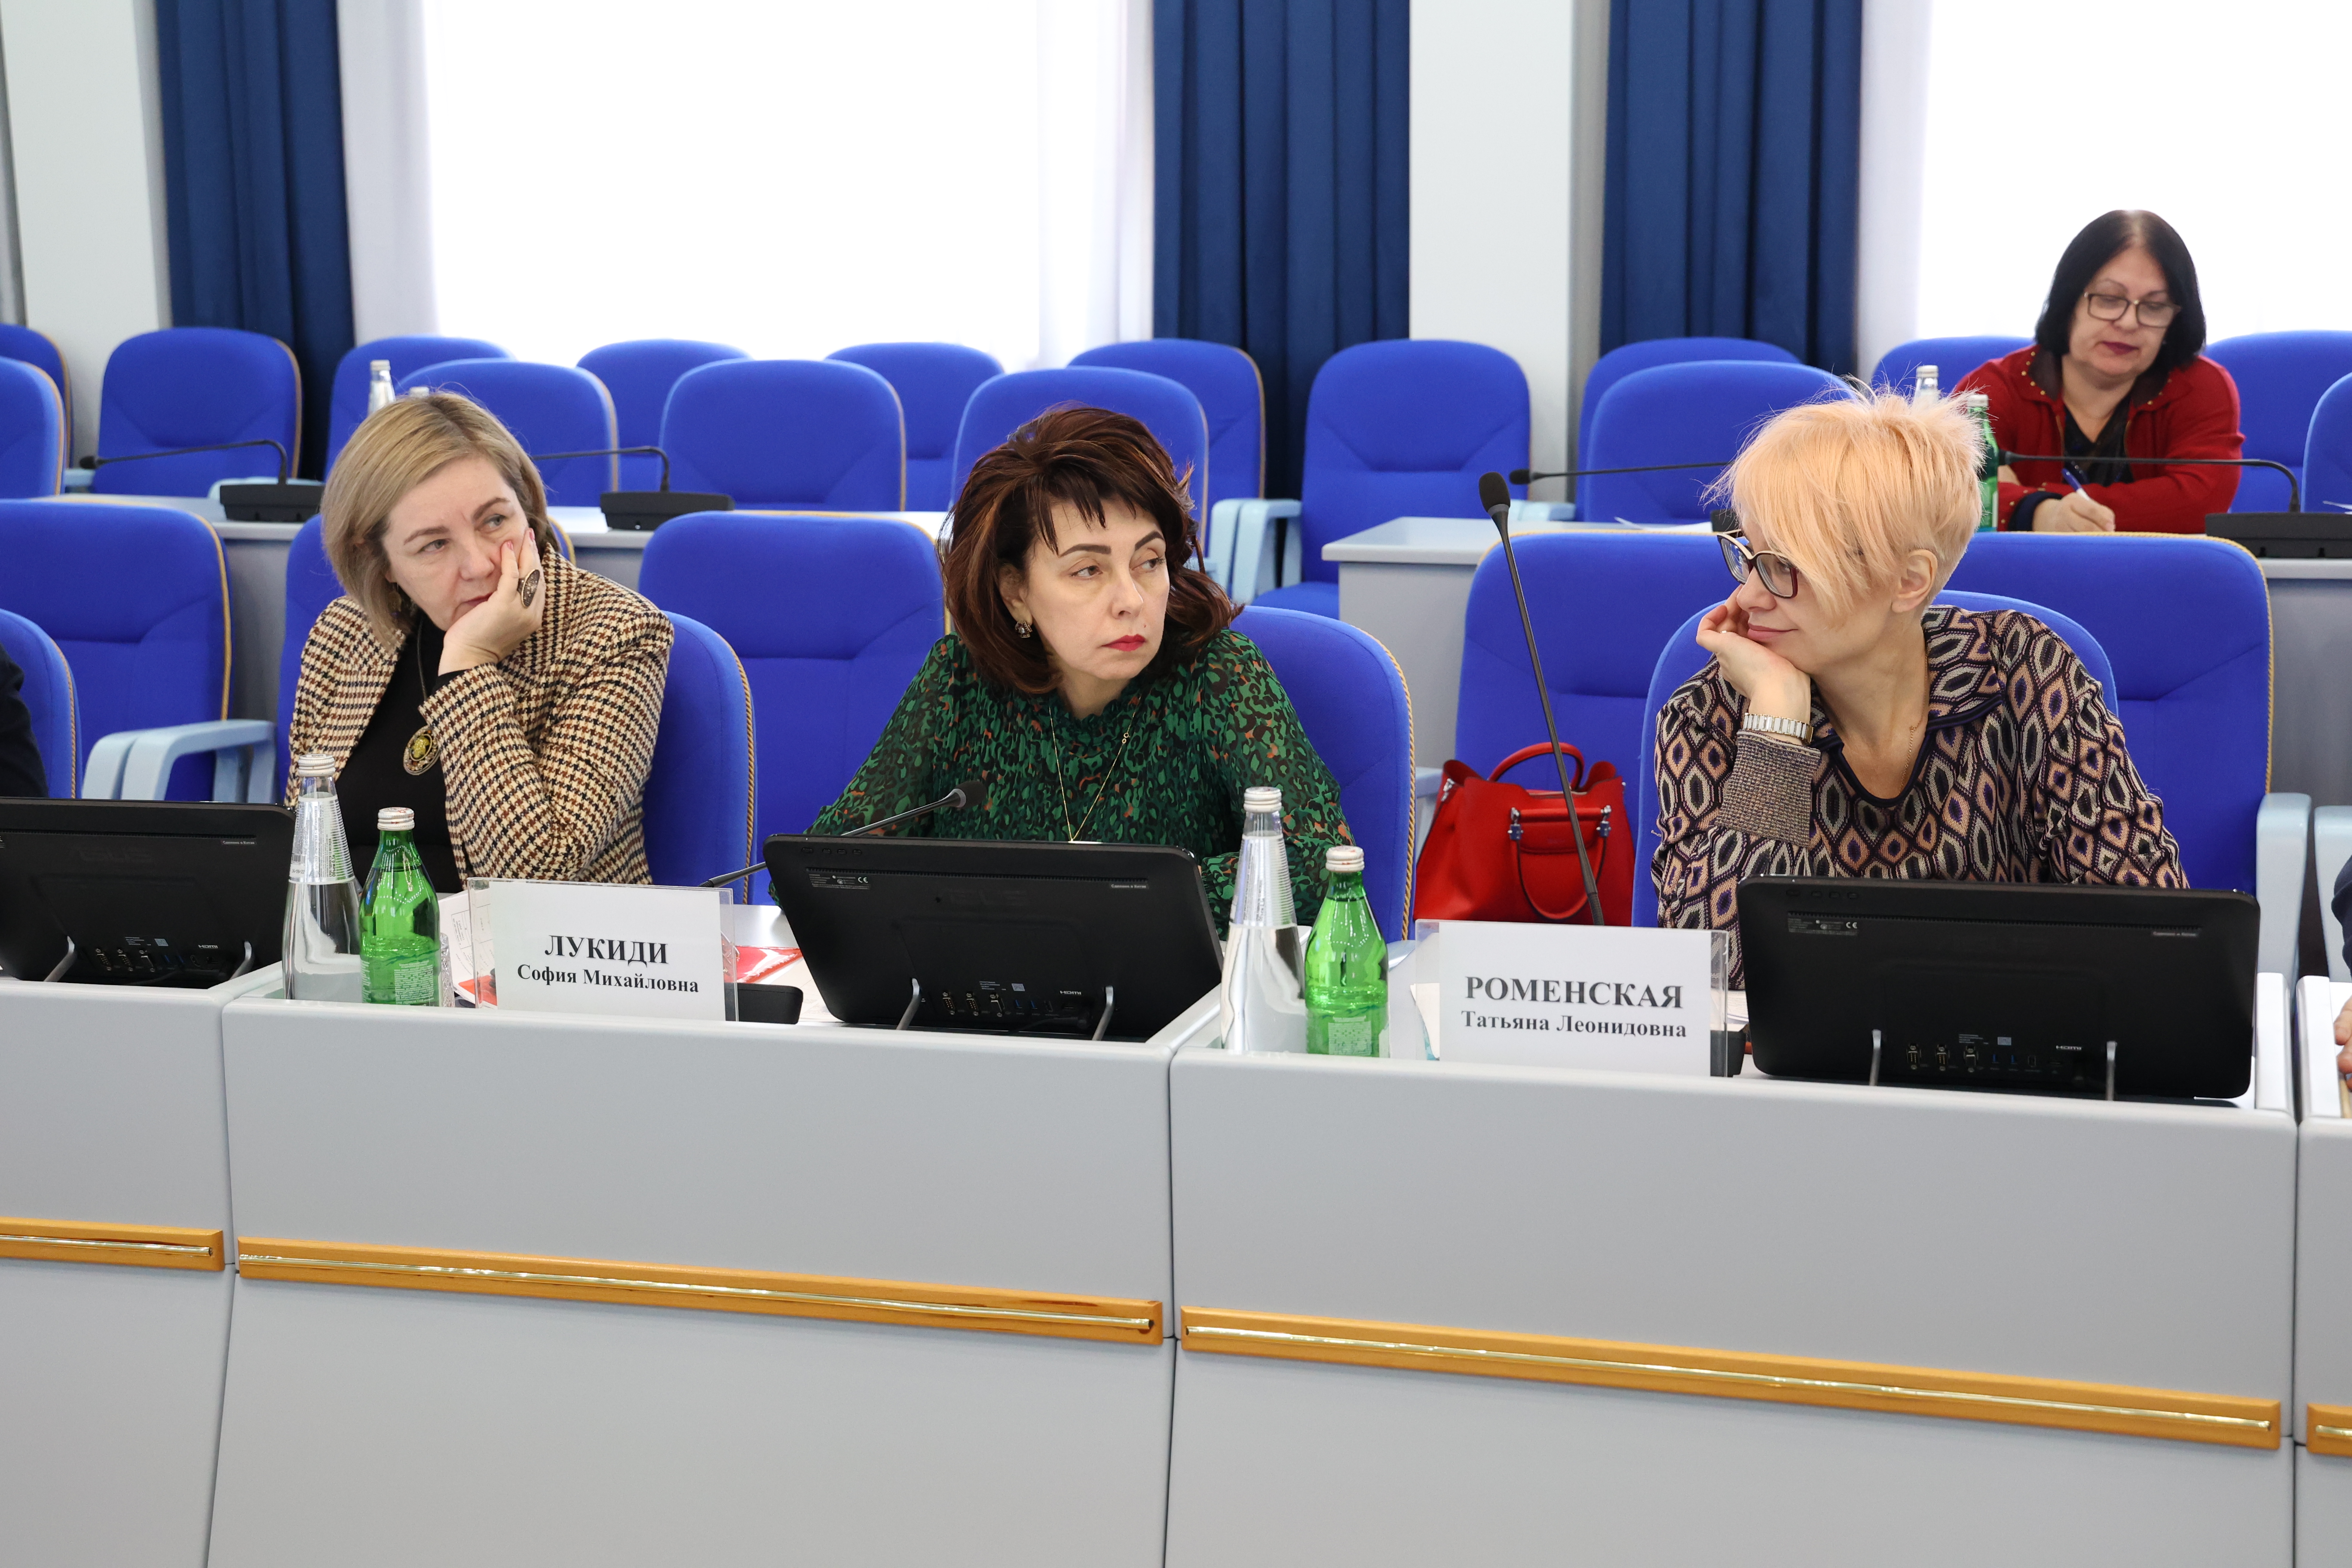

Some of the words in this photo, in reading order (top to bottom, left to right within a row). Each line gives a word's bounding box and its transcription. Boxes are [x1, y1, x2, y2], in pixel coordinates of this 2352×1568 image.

[545, 934, 669, 968] ЛУКИДИ
[517, 964, 577, 985] София
[583, 969, 698, 993] Михайловна
[1465, 976, 1684, 1009] РОМЕНСКАЯ
[1461, 1011, 1549, 1031] Татьяна
[1556, 1015, 1687, 1038] Леонидовна
